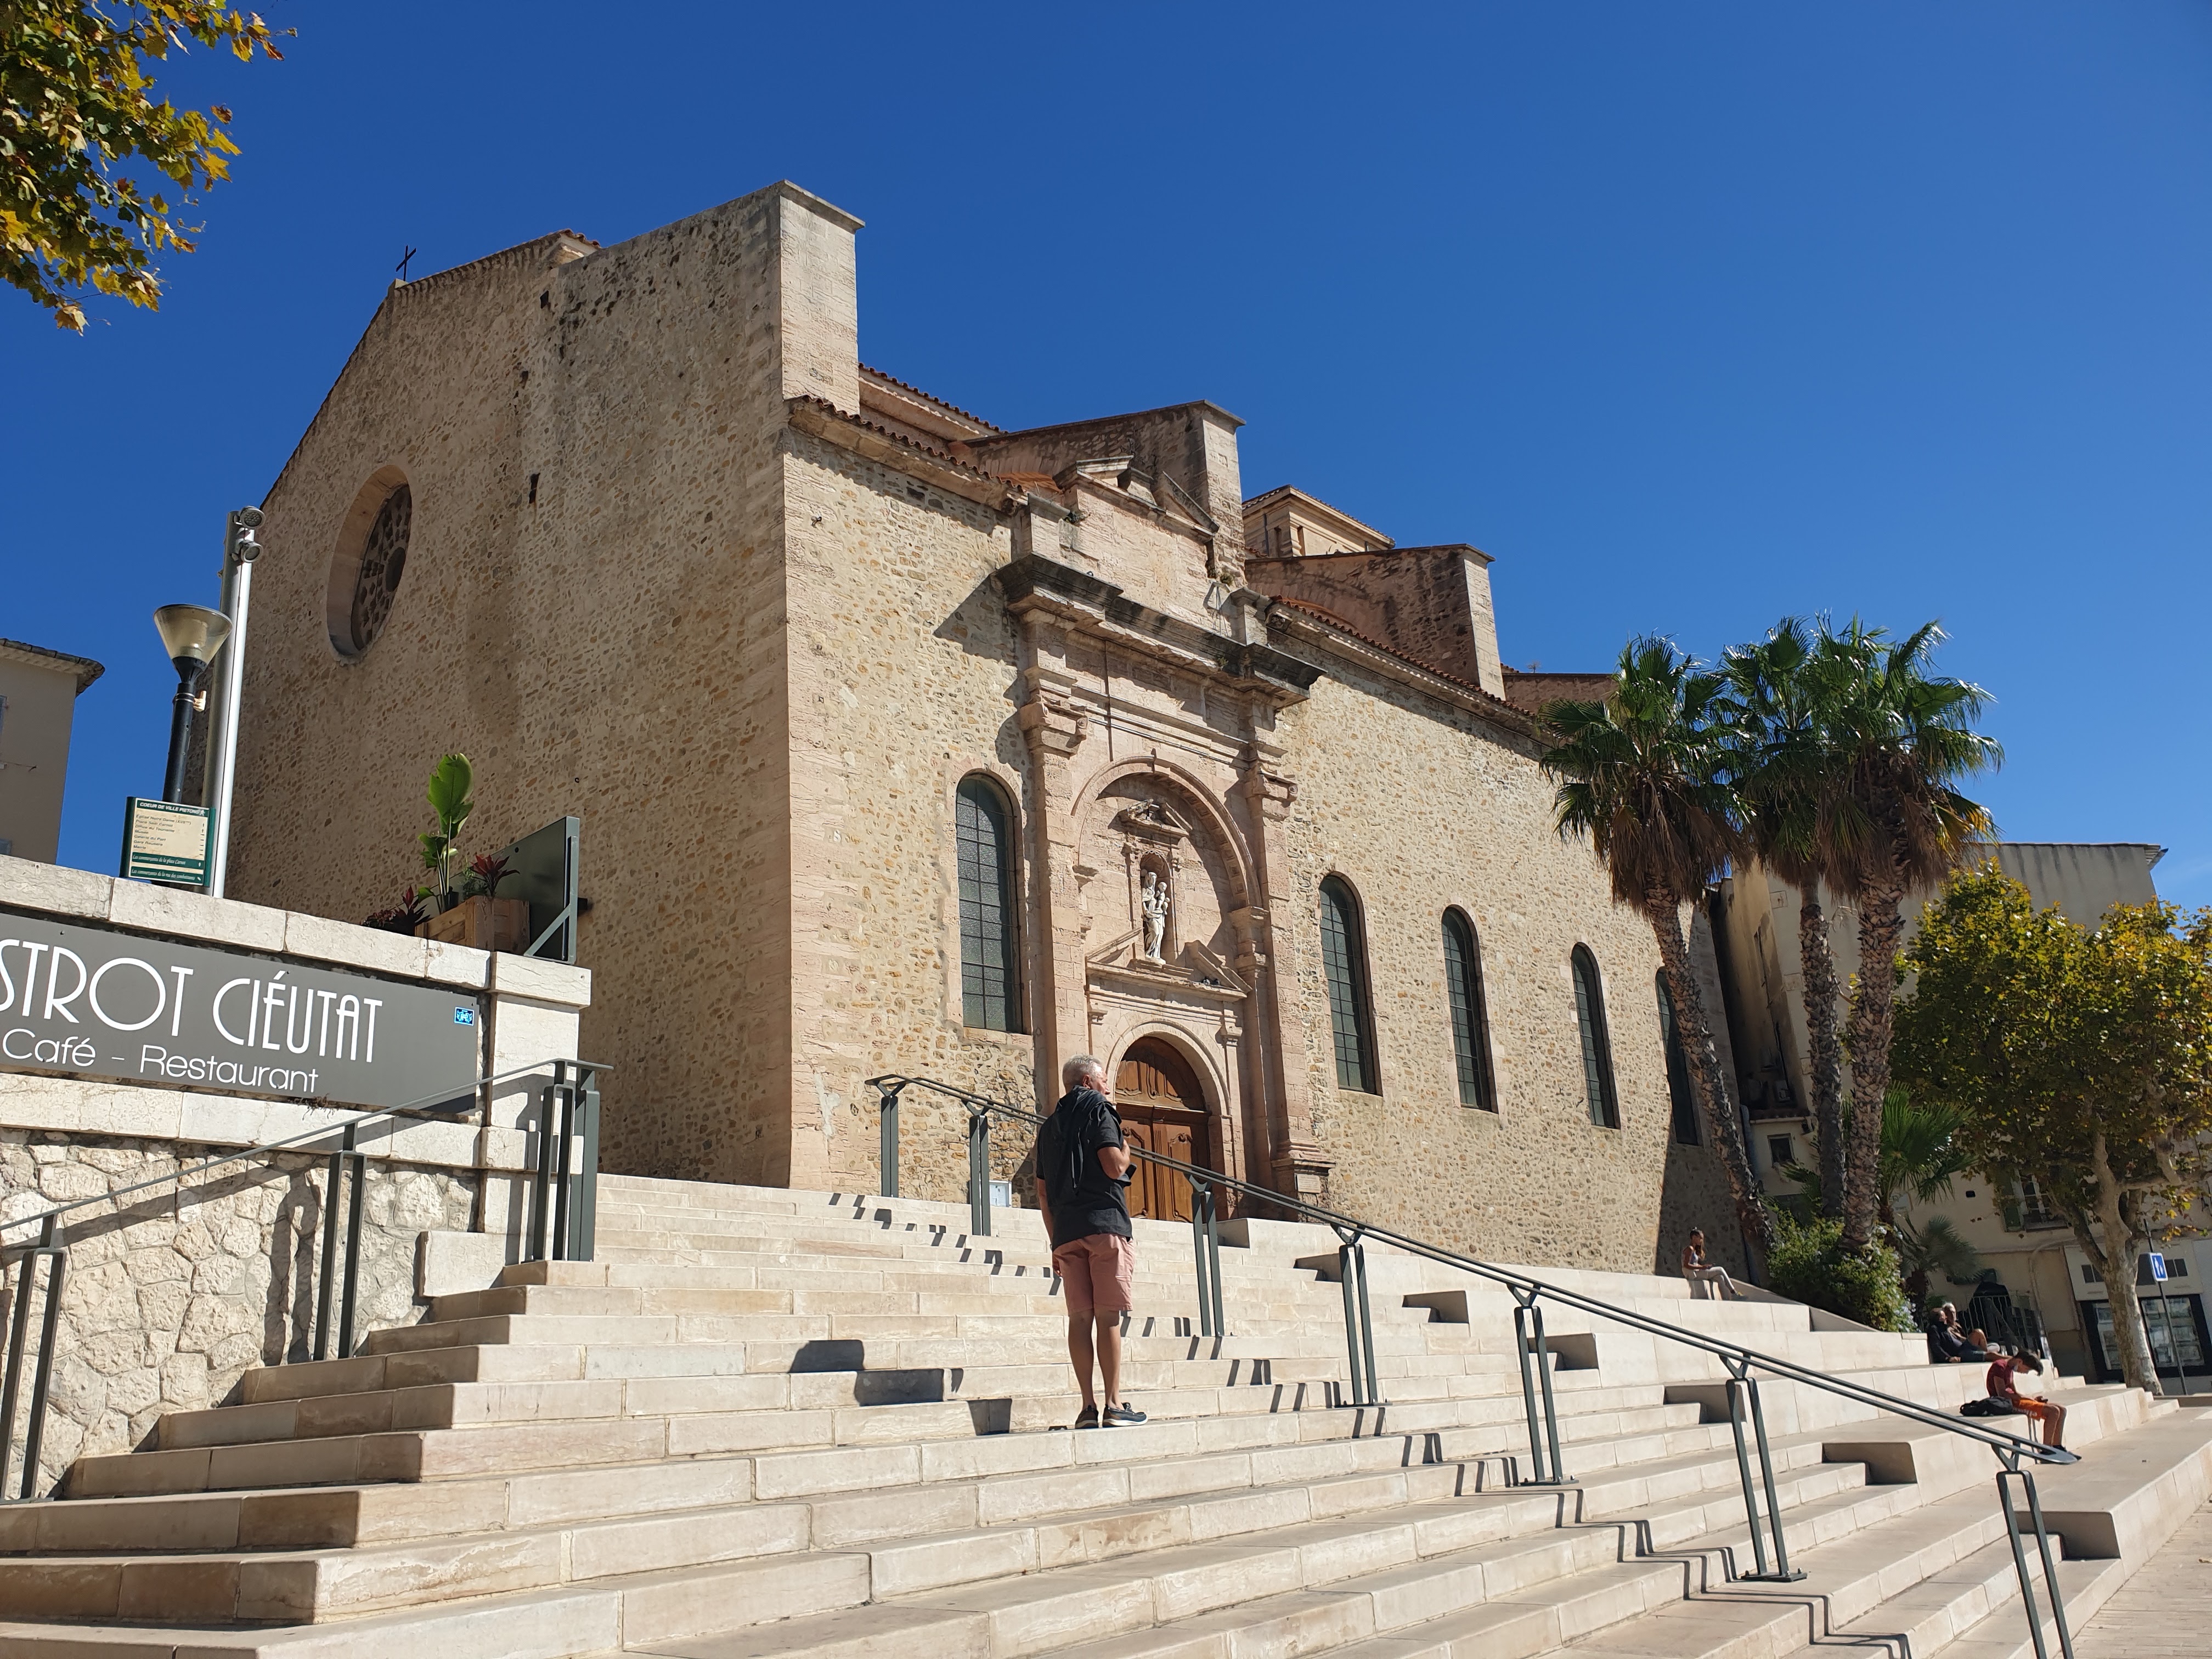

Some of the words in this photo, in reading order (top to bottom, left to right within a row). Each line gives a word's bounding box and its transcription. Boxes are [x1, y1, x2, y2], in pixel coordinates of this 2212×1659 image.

[213, 970, 383, 1063] CIÉUTAT
[2, 1028, 96, 1066] Café
[140, 1044, 319, 1093] Restaurant
